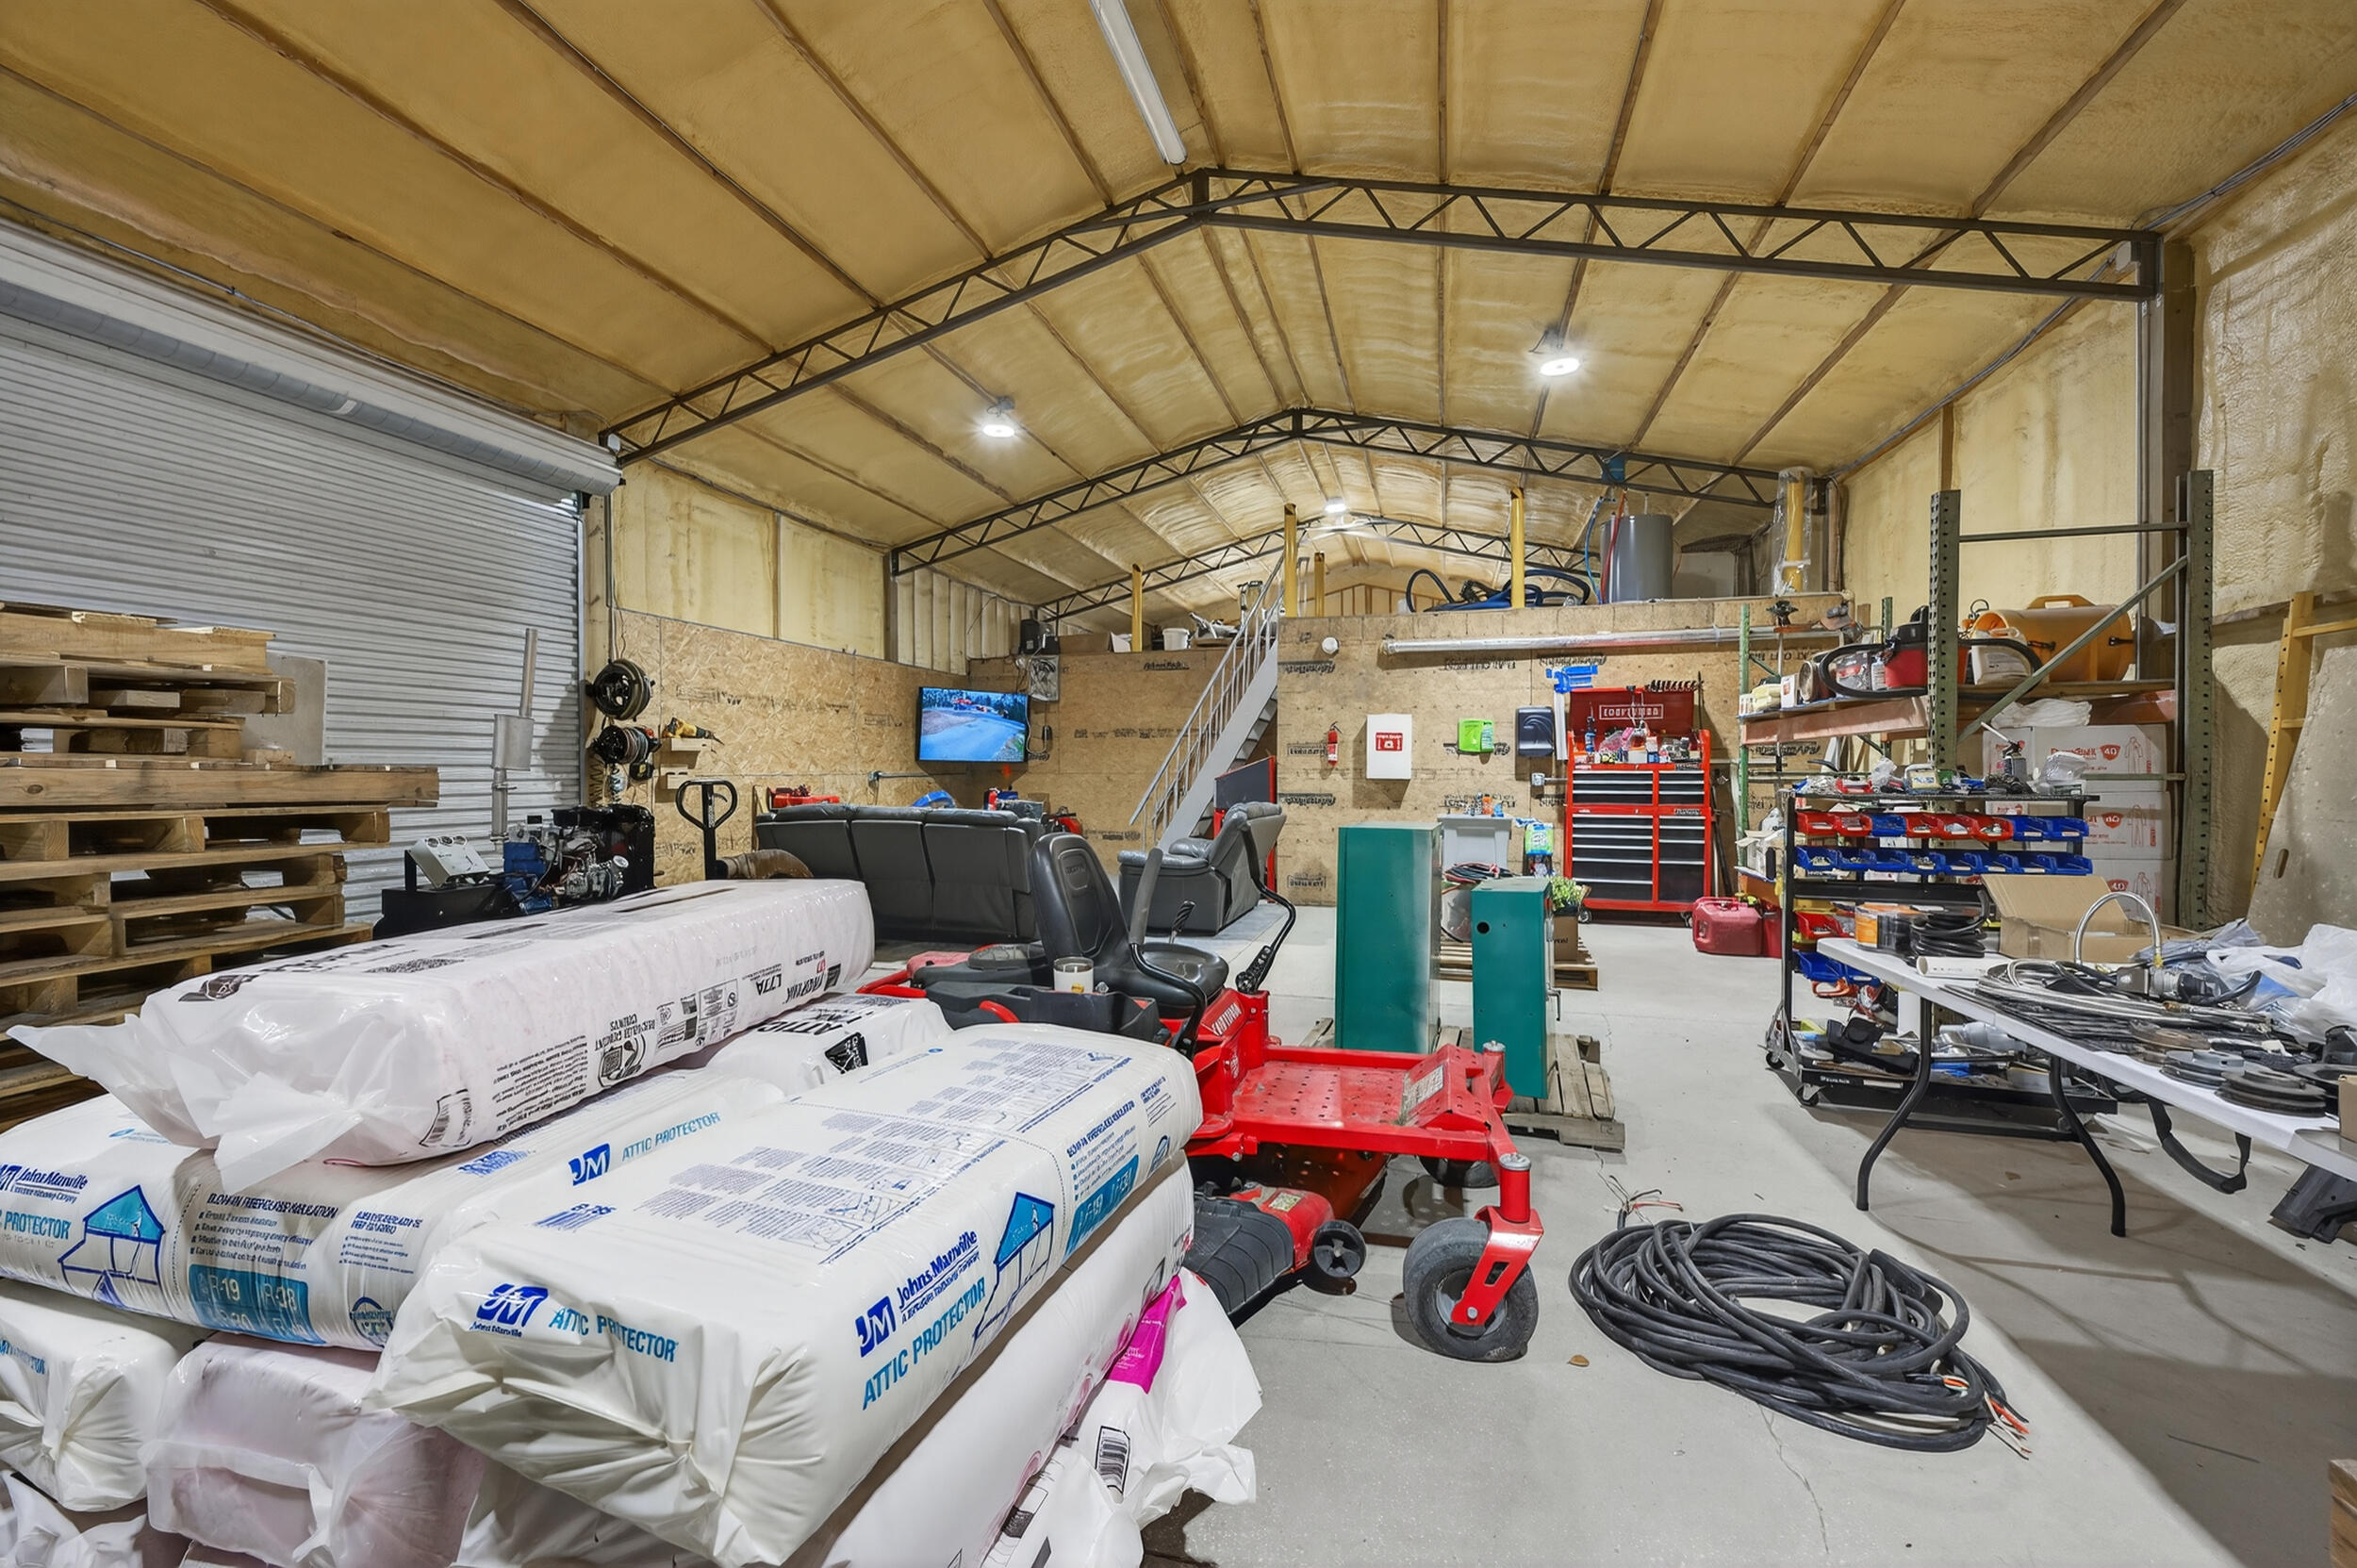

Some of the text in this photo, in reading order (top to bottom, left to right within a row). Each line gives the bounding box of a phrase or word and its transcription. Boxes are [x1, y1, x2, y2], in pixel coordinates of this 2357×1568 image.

[569, 1144, 611, 1186] JM
[622, 1137, 652, 1162] ATTIC
[654, 1112, 721, 1147] PROTECTOR
[4, 1211, 72, 1240] PROTECTOR
[897, 1270, 932, 1310] Johns
[930, 1230, 978, 1279] Manville
[549, 1308, 589, 1336] ATTIC
[855, 1296, 897, 1358] JM
[863, 1349, 908, 1411] ATTIC
[913, 1277, 986, 1364] PROTECTOR
